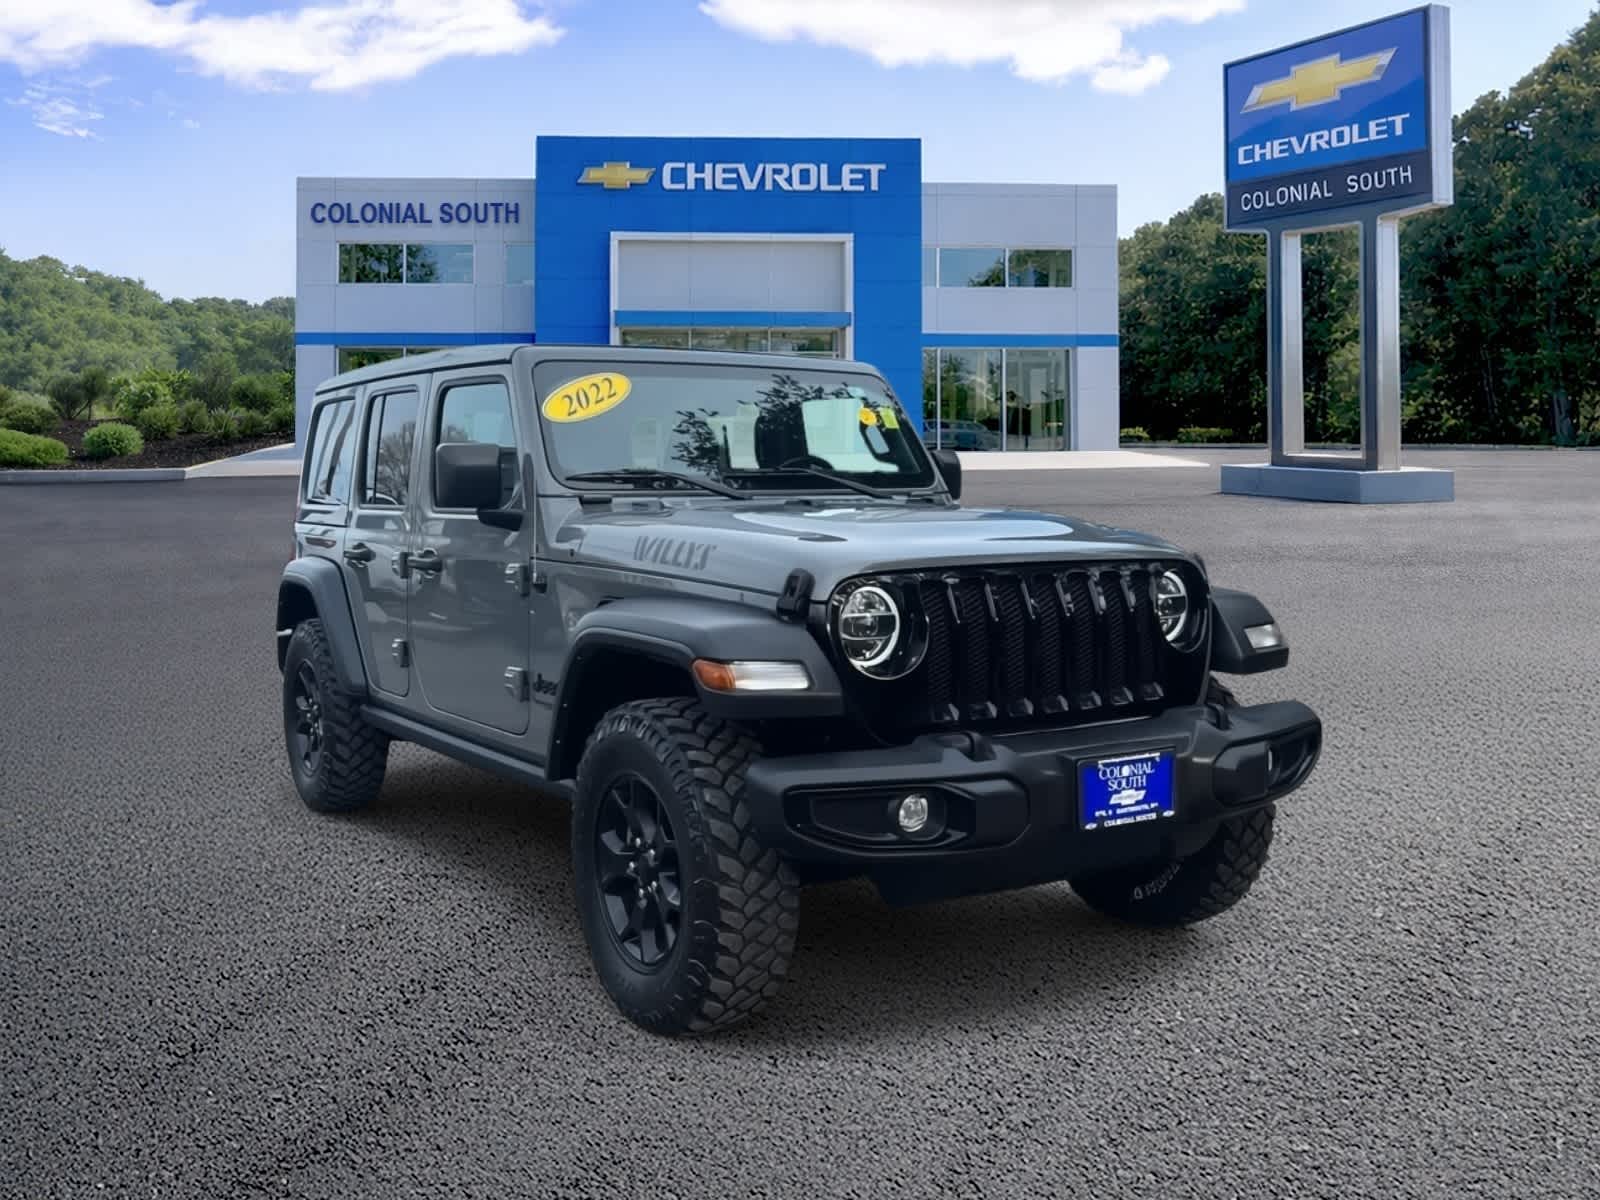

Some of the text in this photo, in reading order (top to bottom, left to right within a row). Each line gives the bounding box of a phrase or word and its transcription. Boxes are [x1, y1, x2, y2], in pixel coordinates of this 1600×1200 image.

[1237, 113, 1410, 165] CHEVROLET
[662, 162, 887, 193] CHEVROLET
[1240, 165, 1413, 212] COLONIAL SOUTH
[310, 202, 521, 225] COLONIAL SOUTH
[561, 377, 617, 417] 2022
[633, 535, 718, 571] WILLYS
[1098, 761, 1156, 781] COLONIAL
[1108, 774, 1147, 791] SOUTH
